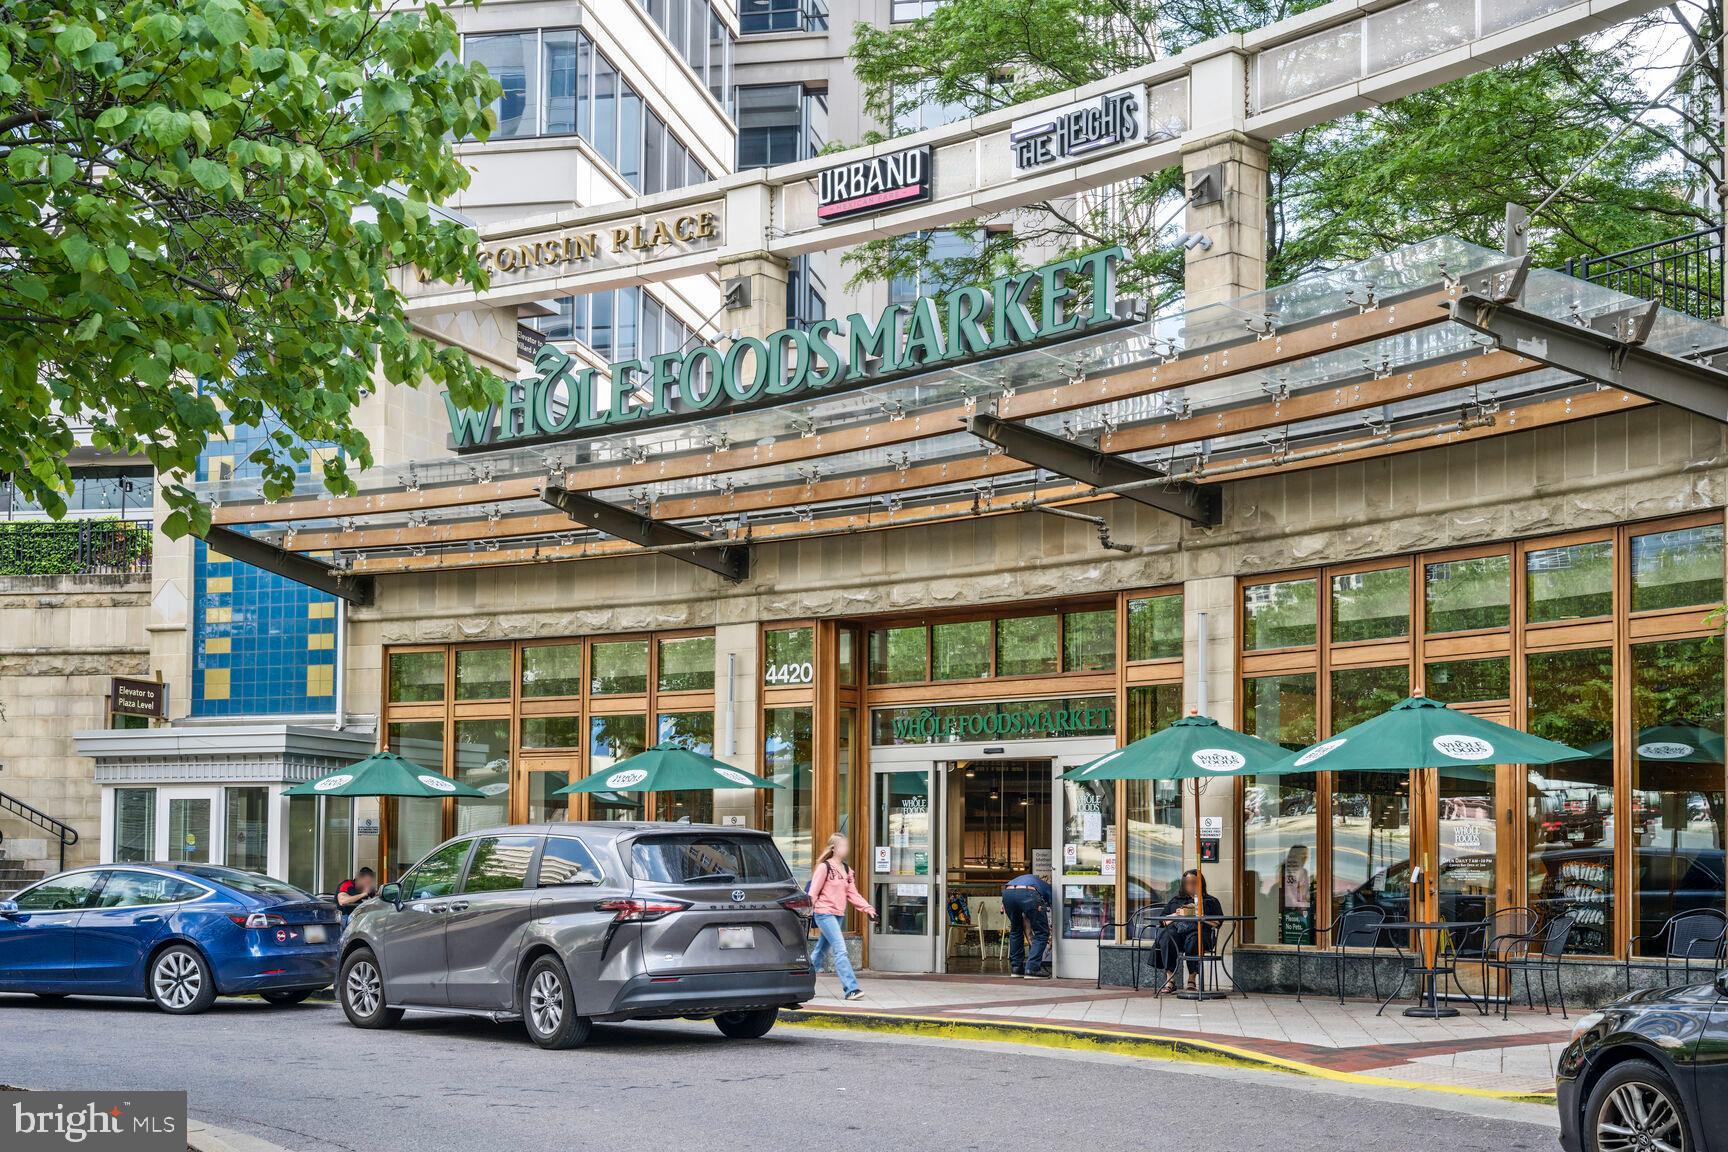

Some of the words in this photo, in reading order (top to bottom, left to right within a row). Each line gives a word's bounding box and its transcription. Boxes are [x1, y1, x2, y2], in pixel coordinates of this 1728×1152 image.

[1010, 135, 1055, 169] THE
[1056, 91, 1138, 157] HEIGHTS
[817, 148, 921, 205] URBANO
[836, 197, 874, 211] MEXICAN
[880, 191, 900, 202] FARE
[609, 210, 716, 254] PLACE
[517, 330, 537, 345] Elevator
[440, 343, 647, 447] WHOLE
[648, 317, 846, 418] FOODS
[846, 246, 1132, 381] MARKET
[765, 661, 813, 684] 4420
[119, 685, 146, 697] Elevator
[147, 690, 155, 698] to
[118, 697, 136, 708] Plaza
[137, 699, 154, 710] Level
[892, 708, 957, 738] WHOLE
[958, 712, 1023, 736] FOODS
[1023, 707, 1115, 734] MARKET
[1437, 740, 1482, 749] WHOLE
[1197, 753, 1239, 761] WHOLE
[902, 796, 926, 807] WHOLE
[903, 807, 925, 815] FOODS
[1454, 823, 1480, 835] WHOLE
[1455, 834, 1480, 843] FOODS
